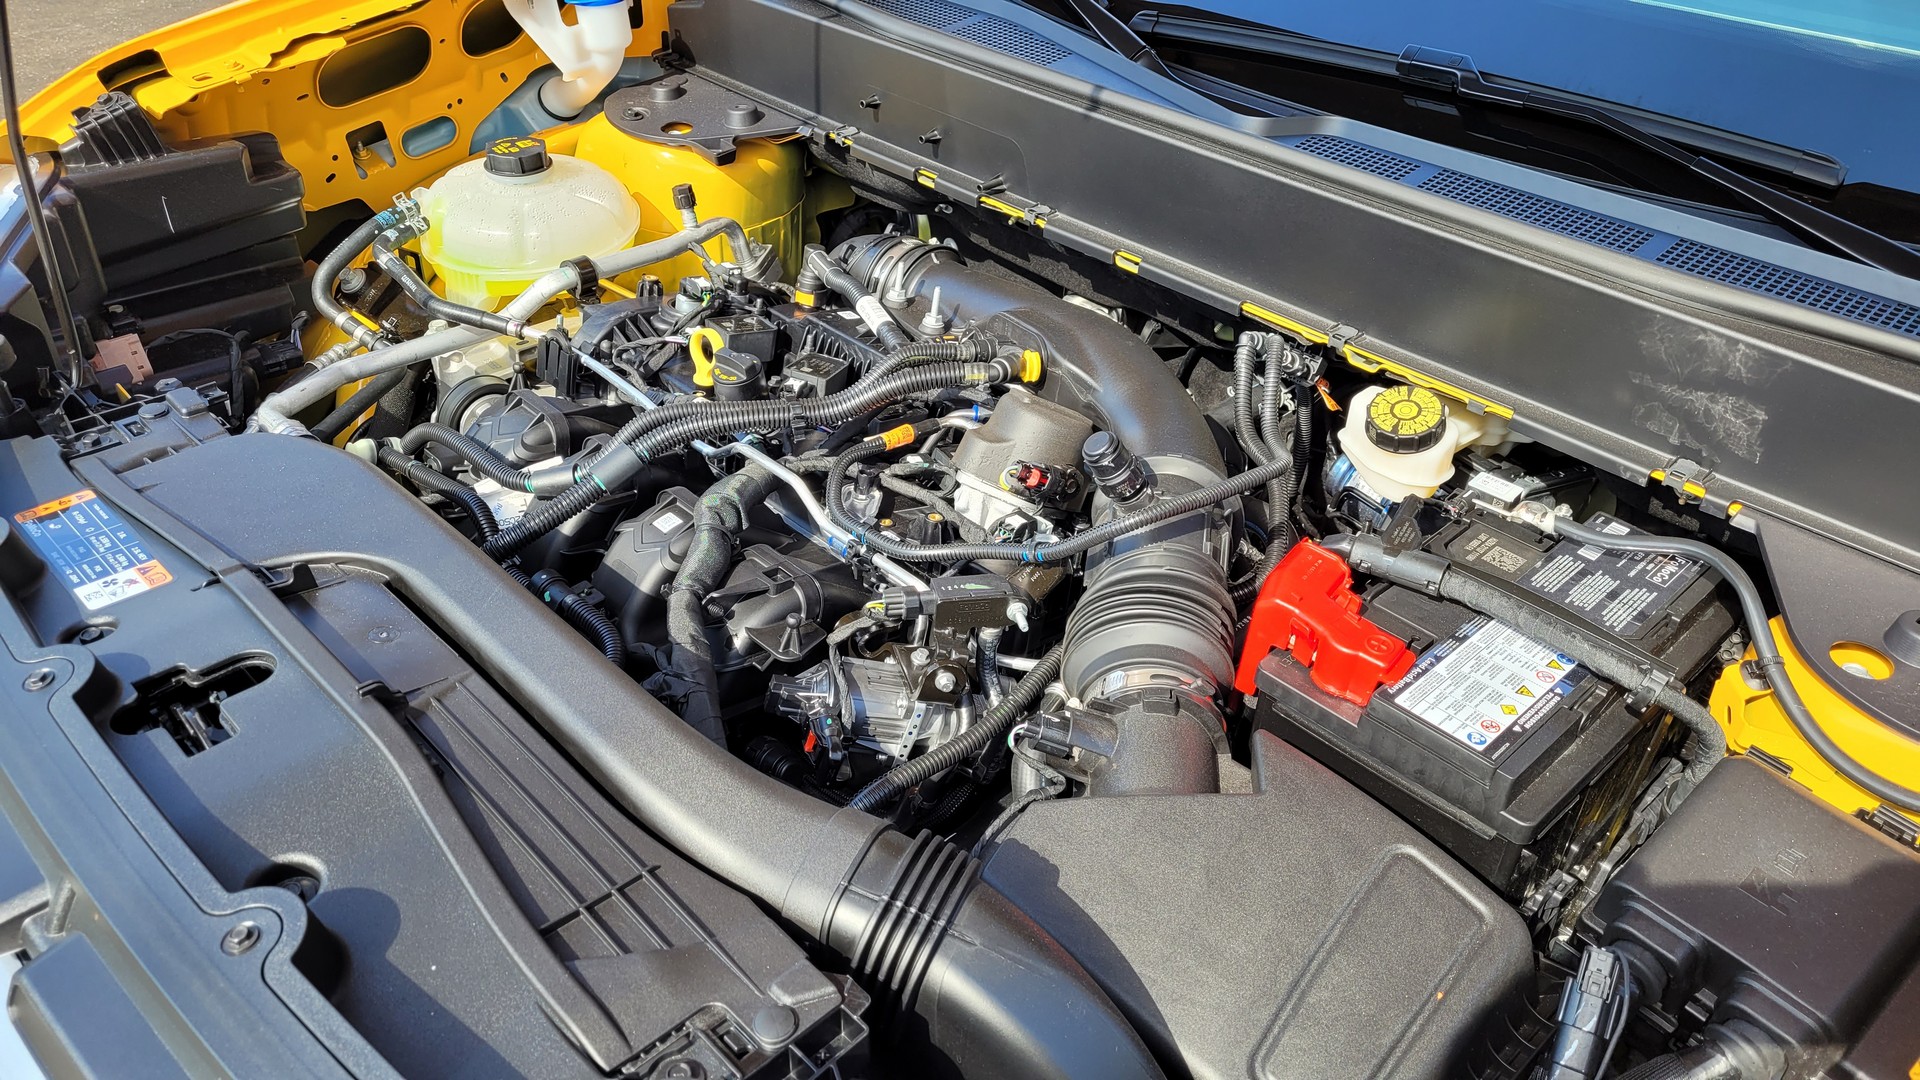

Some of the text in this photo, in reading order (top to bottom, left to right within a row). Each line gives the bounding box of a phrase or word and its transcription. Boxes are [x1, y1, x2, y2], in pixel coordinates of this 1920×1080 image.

[1652, 555, 1686, 584] FoMoCo
[1418, 657, 1436, 671] Lead
[1387, 676, 1412, 695] Battery
